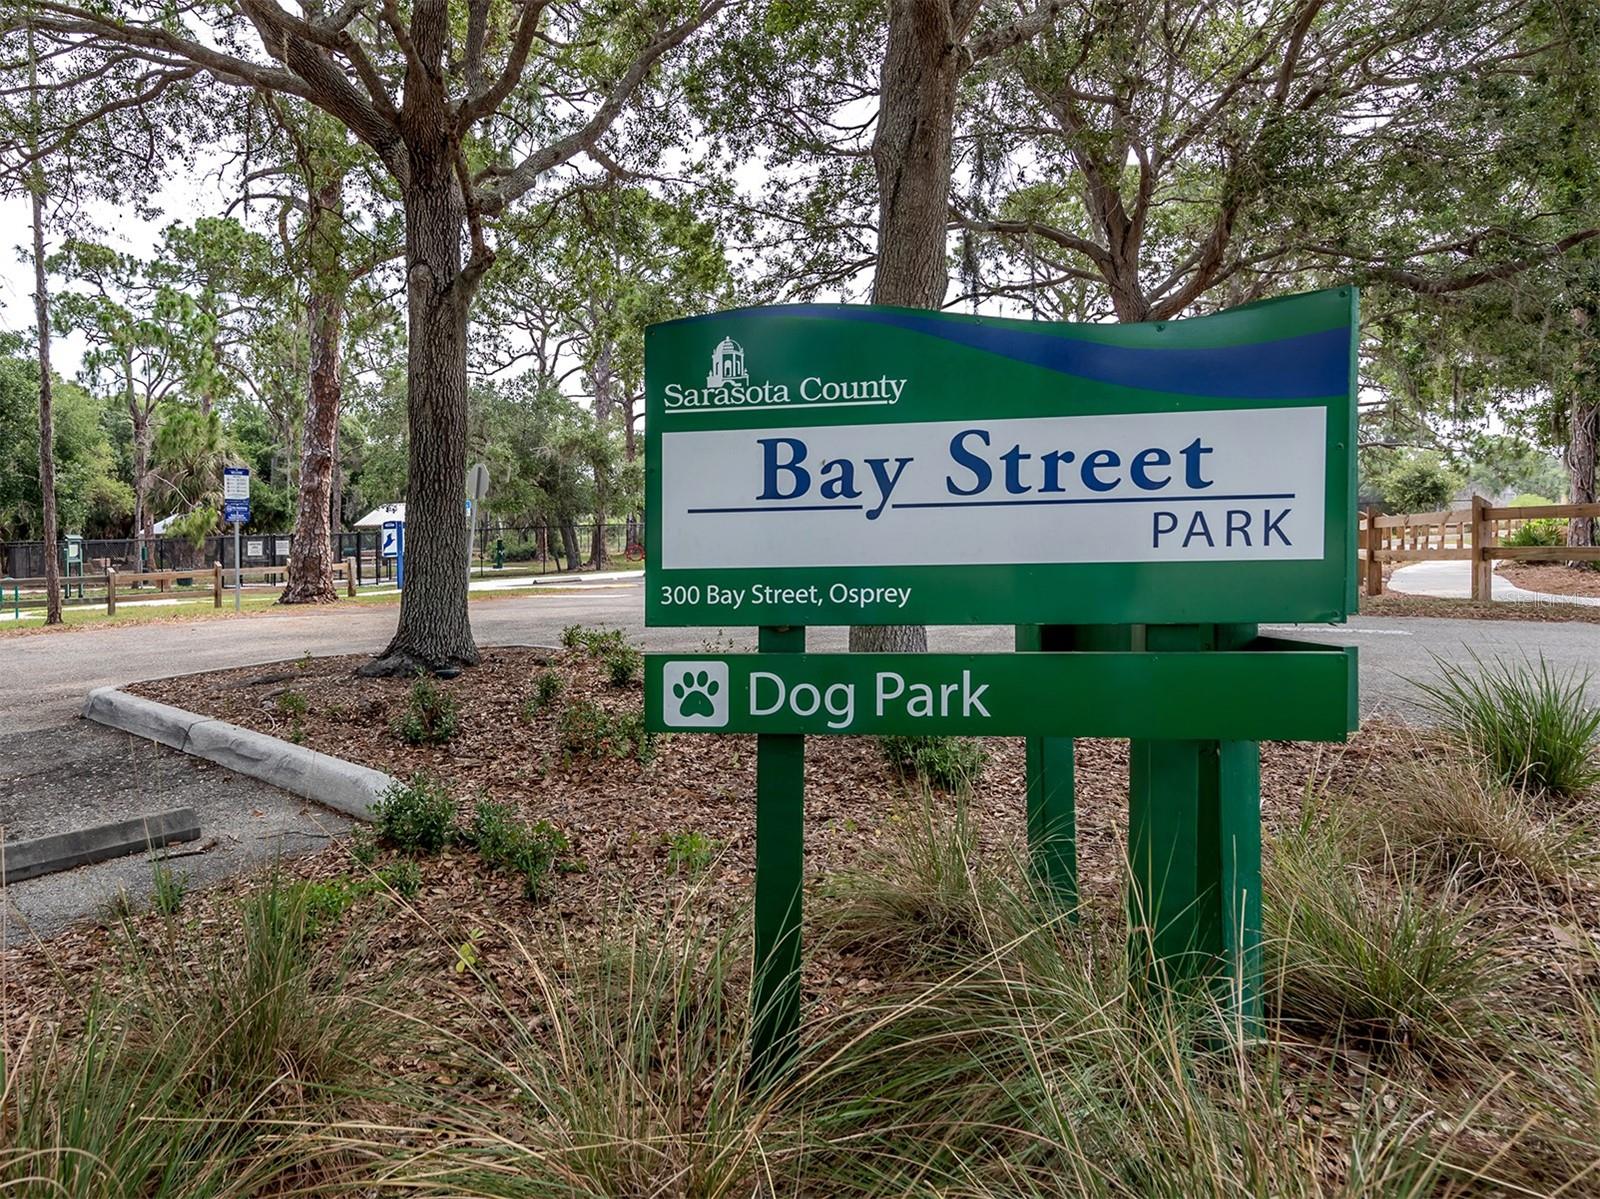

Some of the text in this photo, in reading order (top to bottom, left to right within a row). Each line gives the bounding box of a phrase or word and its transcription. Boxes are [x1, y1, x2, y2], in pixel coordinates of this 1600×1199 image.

[664, 375, 907, 407] Sarasota County
[755, 429, 1214, 520] Bay Street
[1152, 508, 1293, 548] PARK
[660, 583, 912, 609] 300 Bay Street, Osprey
[749, 670, 991, 729] Dog Park
